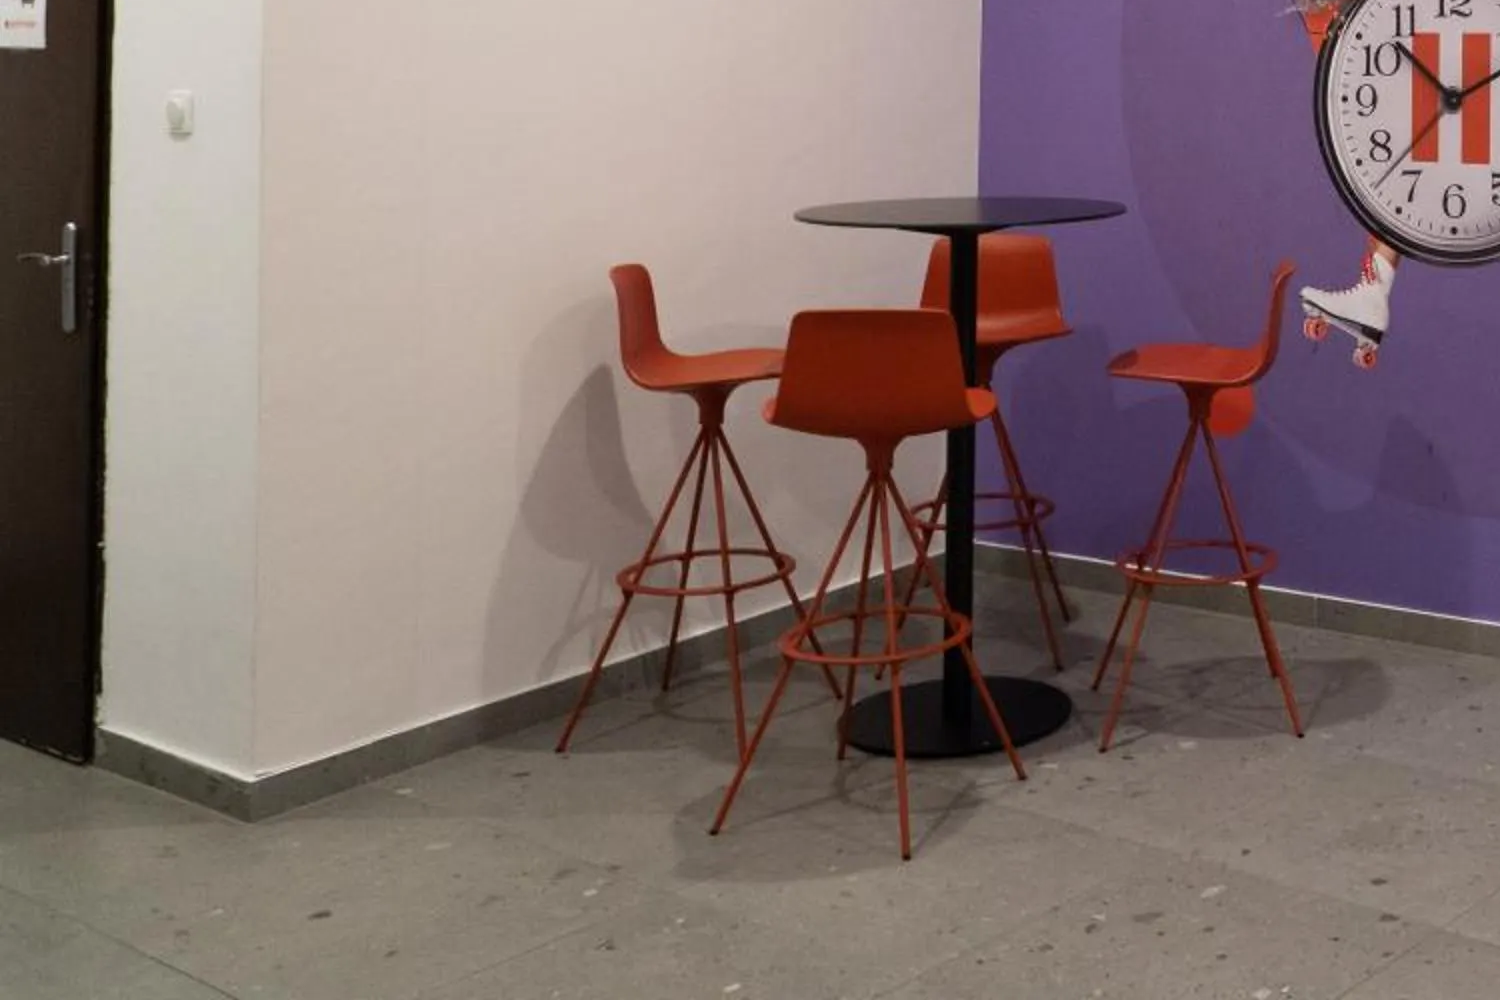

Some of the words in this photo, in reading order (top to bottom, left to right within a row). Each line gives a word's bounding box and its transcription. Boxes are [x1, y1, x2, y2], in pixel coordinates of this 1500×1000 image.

[1391, 4, 1417, 38] 11
[1361, 41, 1402, 77] 10
[1355, 83, 1378, 117] 9
[1369, 129, 1393, 163] 8
[1401, 169, 1423, 203] 7
[1442, 184, 1467, 219] 6
